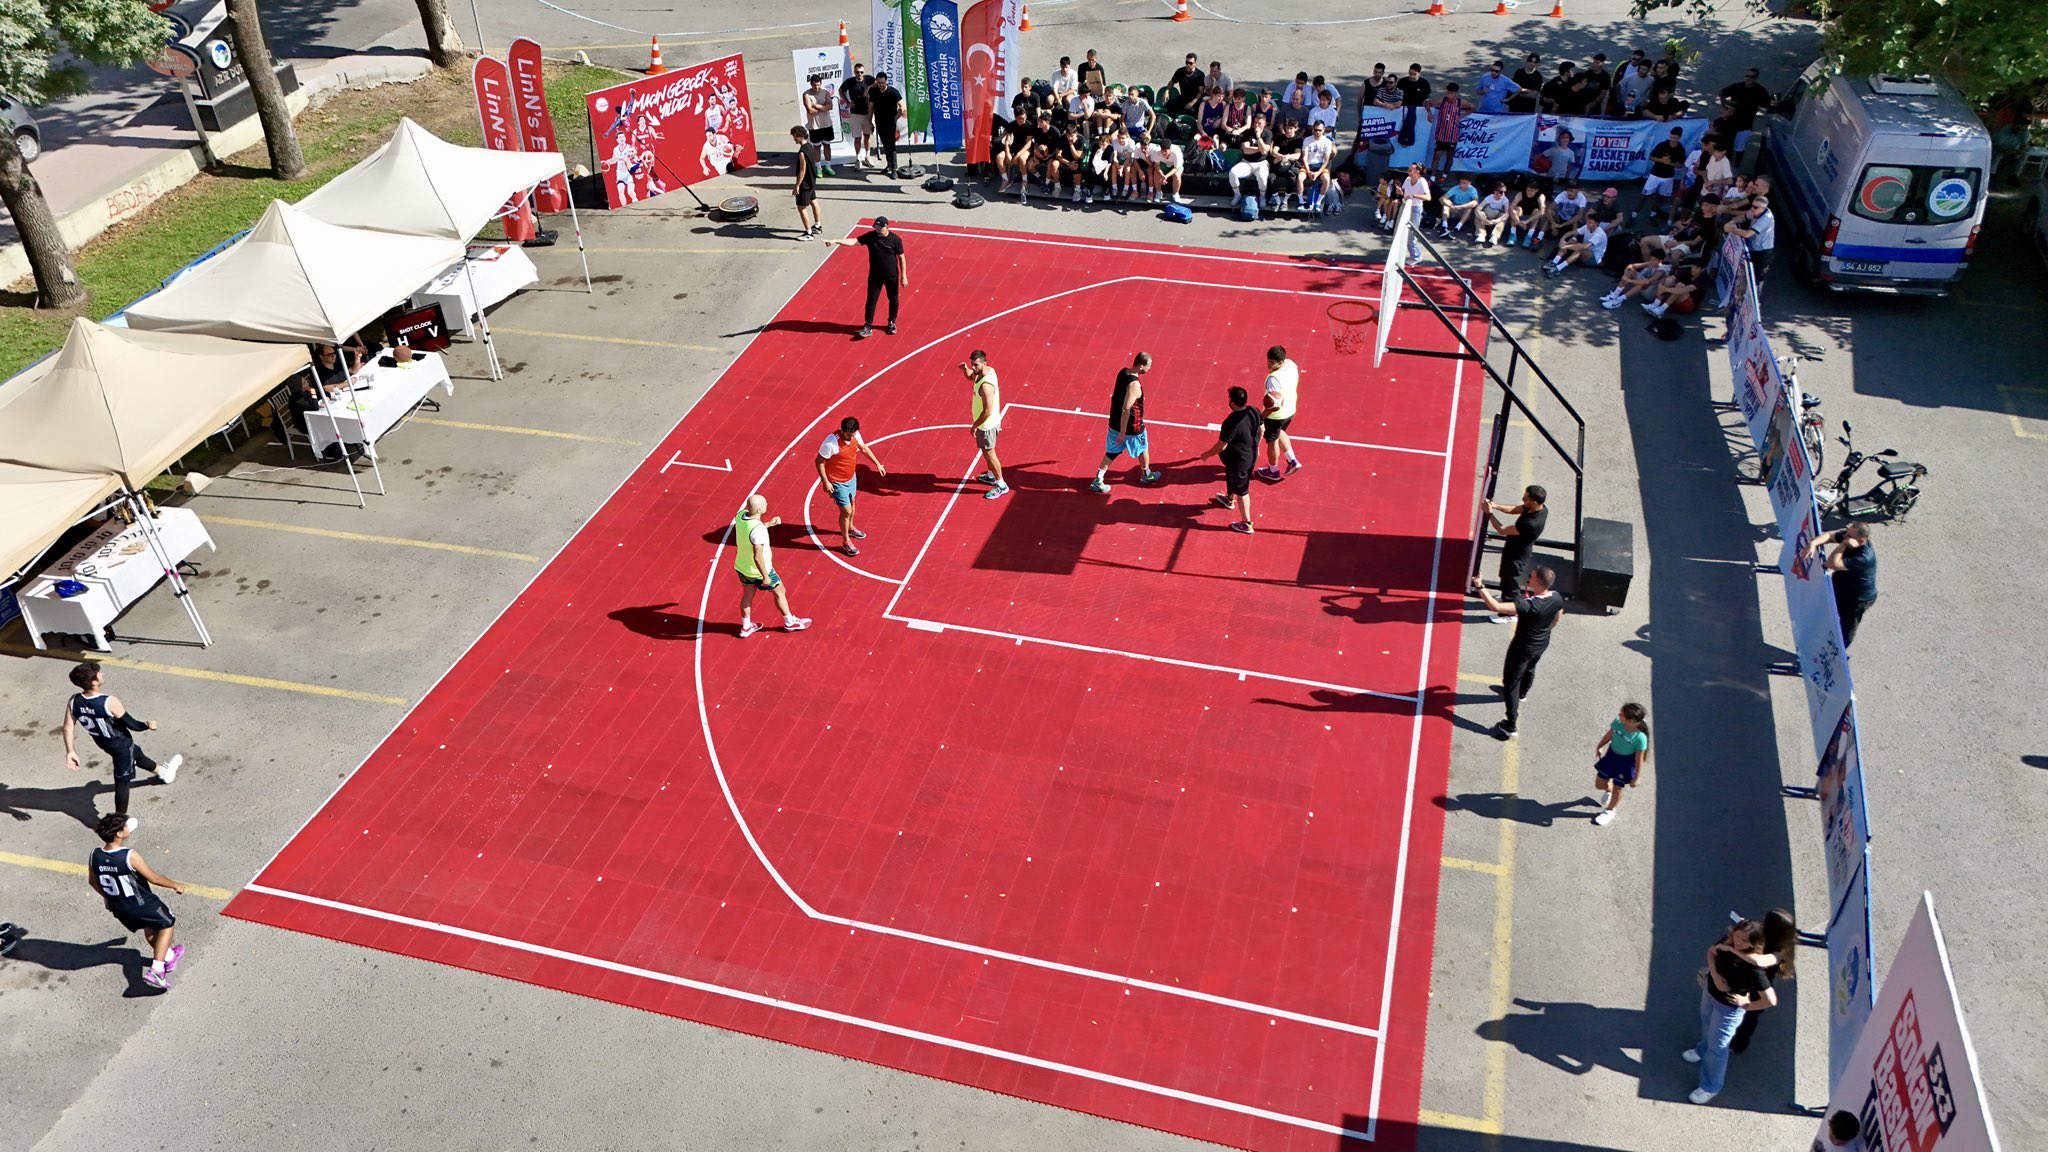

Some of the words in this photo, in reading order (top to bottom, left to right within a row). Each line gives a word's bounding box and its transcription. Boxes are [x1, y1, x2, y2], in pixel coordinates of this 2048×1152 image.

[908, 45, 916, 93] SAKARYA
[916, 38, 924, 103] BÜYÜKŞEHİR
[517, 58, 543, 129] LinN's
[931, 61, 942, 109] SAKARYA
[940, 53, 951, 120] BÜYÜKŞEHİR
[949, 56, 960, 116] BELEDİYESİ
[483, 77, 507, 150] LinN's
[1362, 118, 1385, 126] KARYA
[1459, 118, 1490, 131] SPOR
[1459, 131, 1497, 144] ENİNLE
[1595, 137, 1606, 147] 10
[1590, 149, 1646, 161] BASKETBOL
[1588, 161, 1626, 172] SAHASI
[1846, 262, 1855, 270] 54
[399, 326, 414, 335] SHOT
[414, 320, 433, 330] CLOCK
[428, 325, 438, 338] V
[397, 335, 409, 347] H
[78, 716, 111, 738] 21
[99, 874, 136, 898] 91
[1895, 998, 1935, 1139] Sokak
[1928, 1054, 1953, 1125] 3x3
